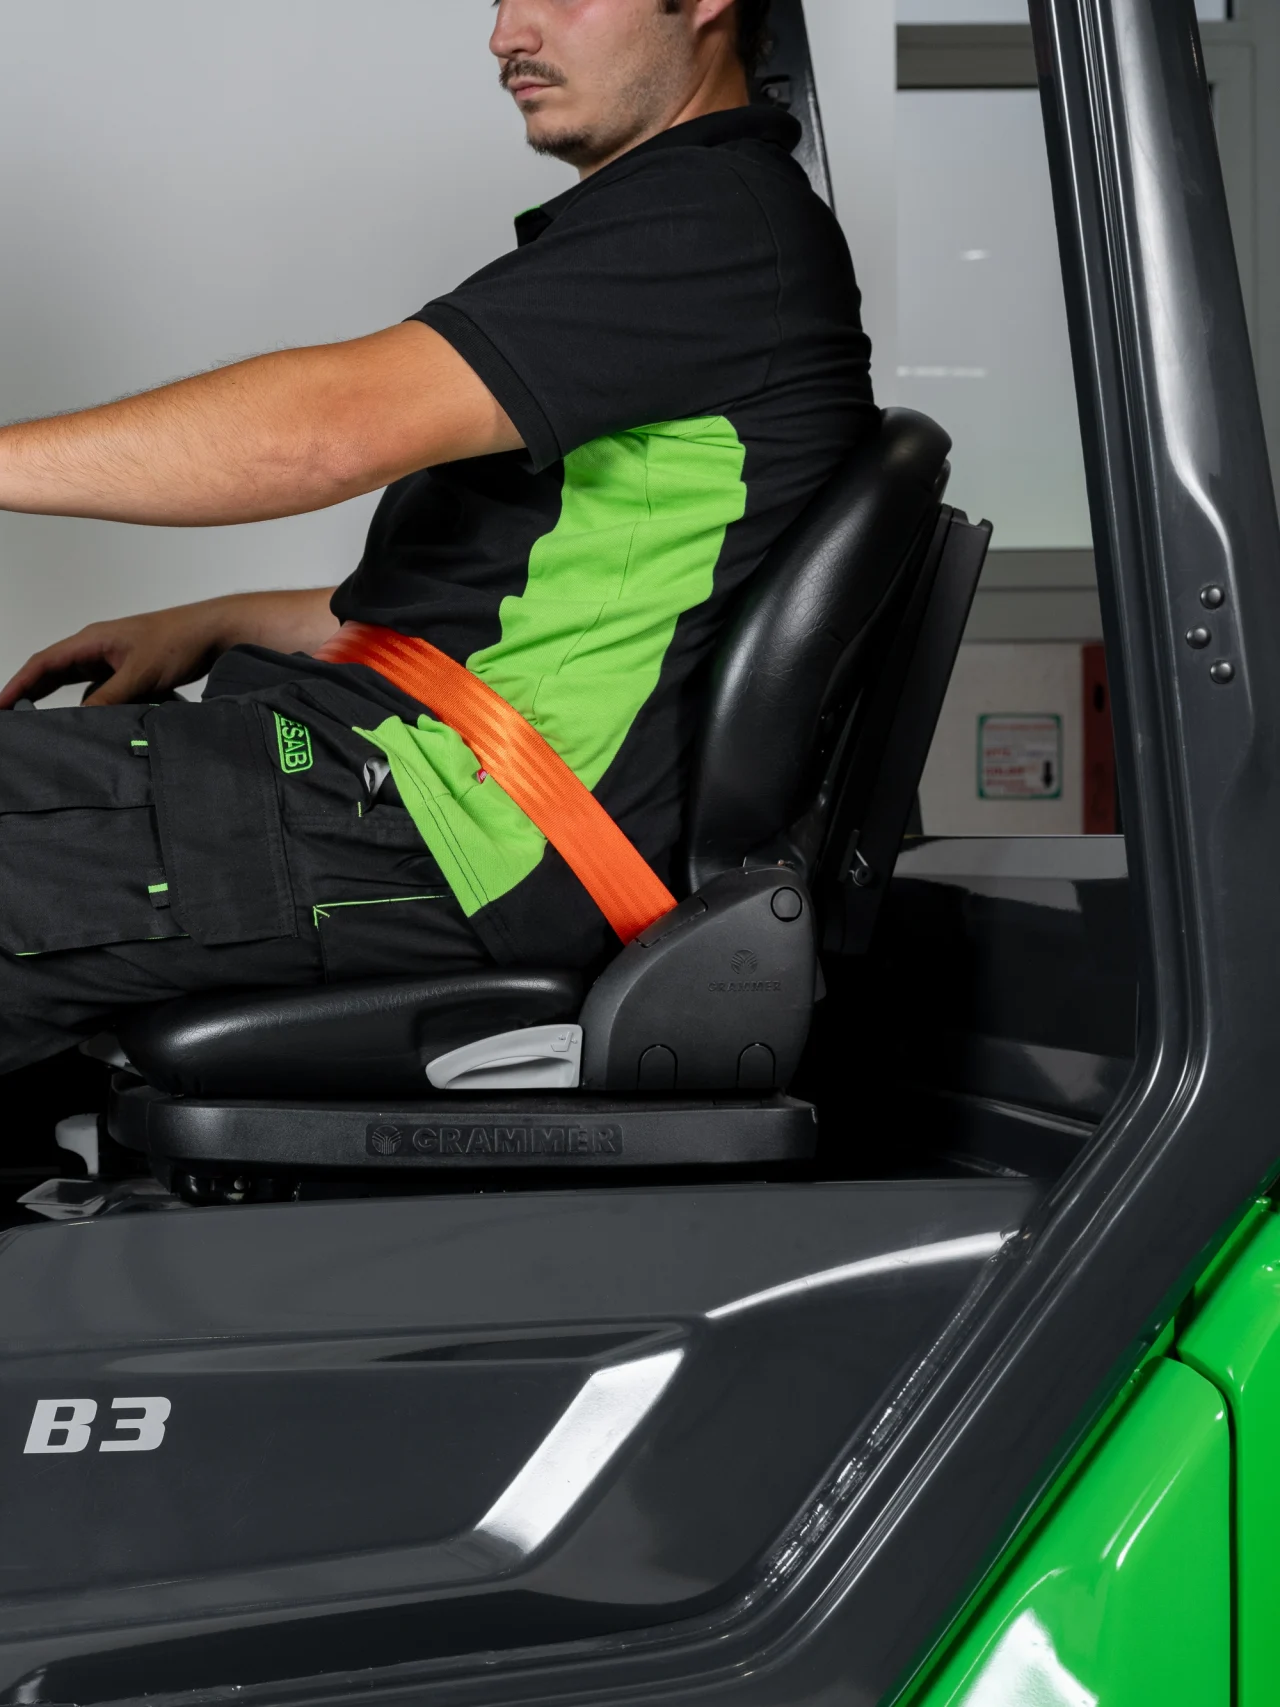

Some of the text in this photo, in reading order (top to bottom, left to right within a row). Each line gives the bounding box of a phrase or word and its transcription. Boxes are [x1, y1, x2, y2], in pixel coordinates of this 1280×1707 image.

[278, 715, 307, 767] ESAB
[707, 980, 782, 992] GRAMMER
[412, 1127, 617, 1154] GRAMMER
[23, 1396, 172, 1454] B3
